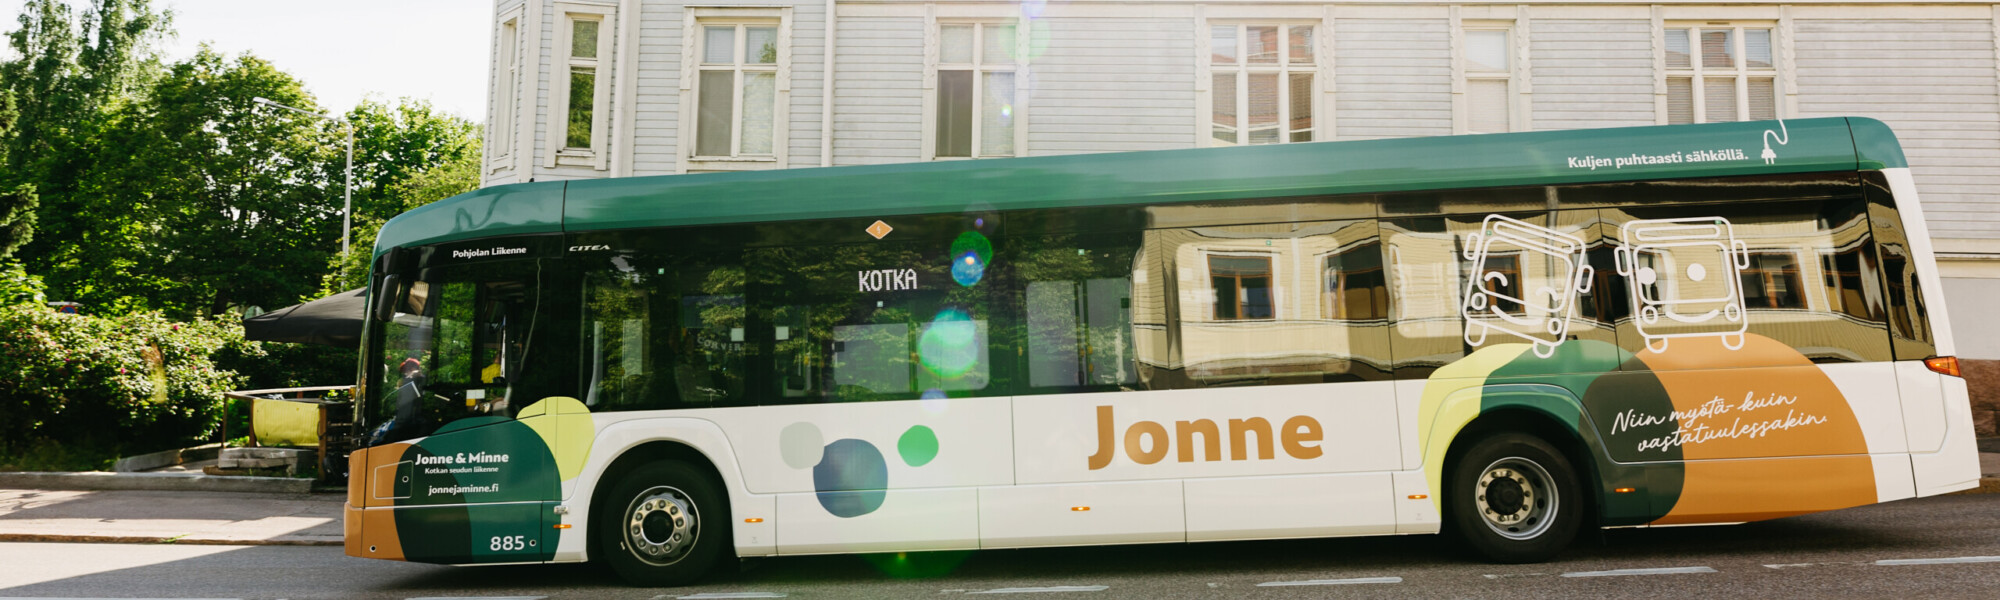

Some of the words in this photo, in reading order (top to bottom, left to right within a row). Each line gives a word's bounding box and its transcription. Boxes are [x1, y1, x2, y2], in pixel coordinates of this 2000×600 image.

[1567, 156, 1613, 171] Kuljen
[1615, 151, 1683, 169] puhtaasti
[1685, 149, 1749, 163] sähköllä.
[452, 248, 490, 259] Pohjolan
[491, 246, 527, 256] Liikenne
[568, 244, 611, 252] CITEA
[858, 268, 918, 292] KOTKA
[1611, 408, 1666, 436] Niin
[1669, 395, 1735, 429] myötä-
[1736, 391, 1798, 412] kuin
[1087, 404, 1324, 471] Jonne
[1637, 409, 1828, 453] vastatuulessakin.
[415, 453, 454, 466] Jonne
[455, 452, 467, 464] &
[468, 451, 510, 464] Minne
[449, 466, 473, 474] seudun
[428, 483, 499, 496] jonnejaminne.fi
[490, 535, 525, 551] 885
